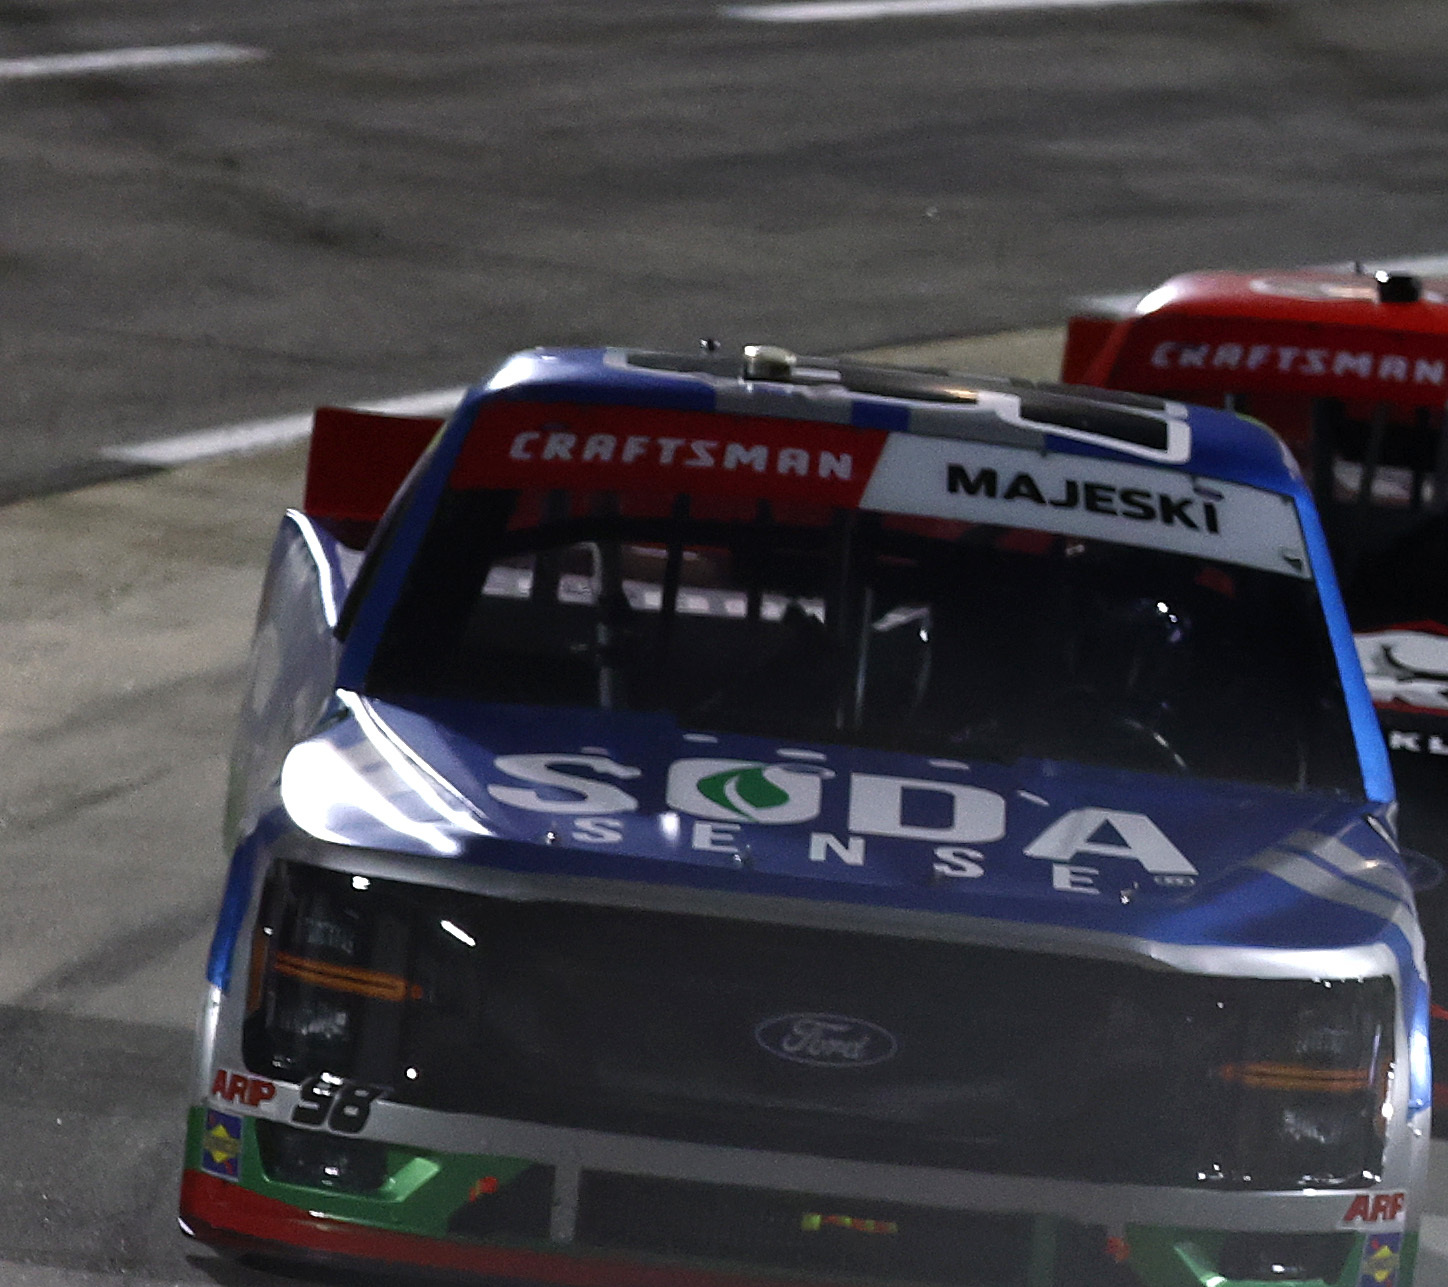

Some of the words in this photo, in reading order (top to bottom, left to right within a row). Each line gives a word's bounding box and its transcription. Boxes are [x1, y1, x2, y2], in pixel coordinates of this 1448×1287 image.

[1150, 340, 1446, 387] CRAFTSMAN
[508, 429, 854, 482] CRAFTSMAN
[944, 462, 1222, 536] MAJESKI
[486, 750, 1202, 878] SODA
[572, 813, 1103, 896] SENSE
[211, 1069, 277, 1108] ARP
